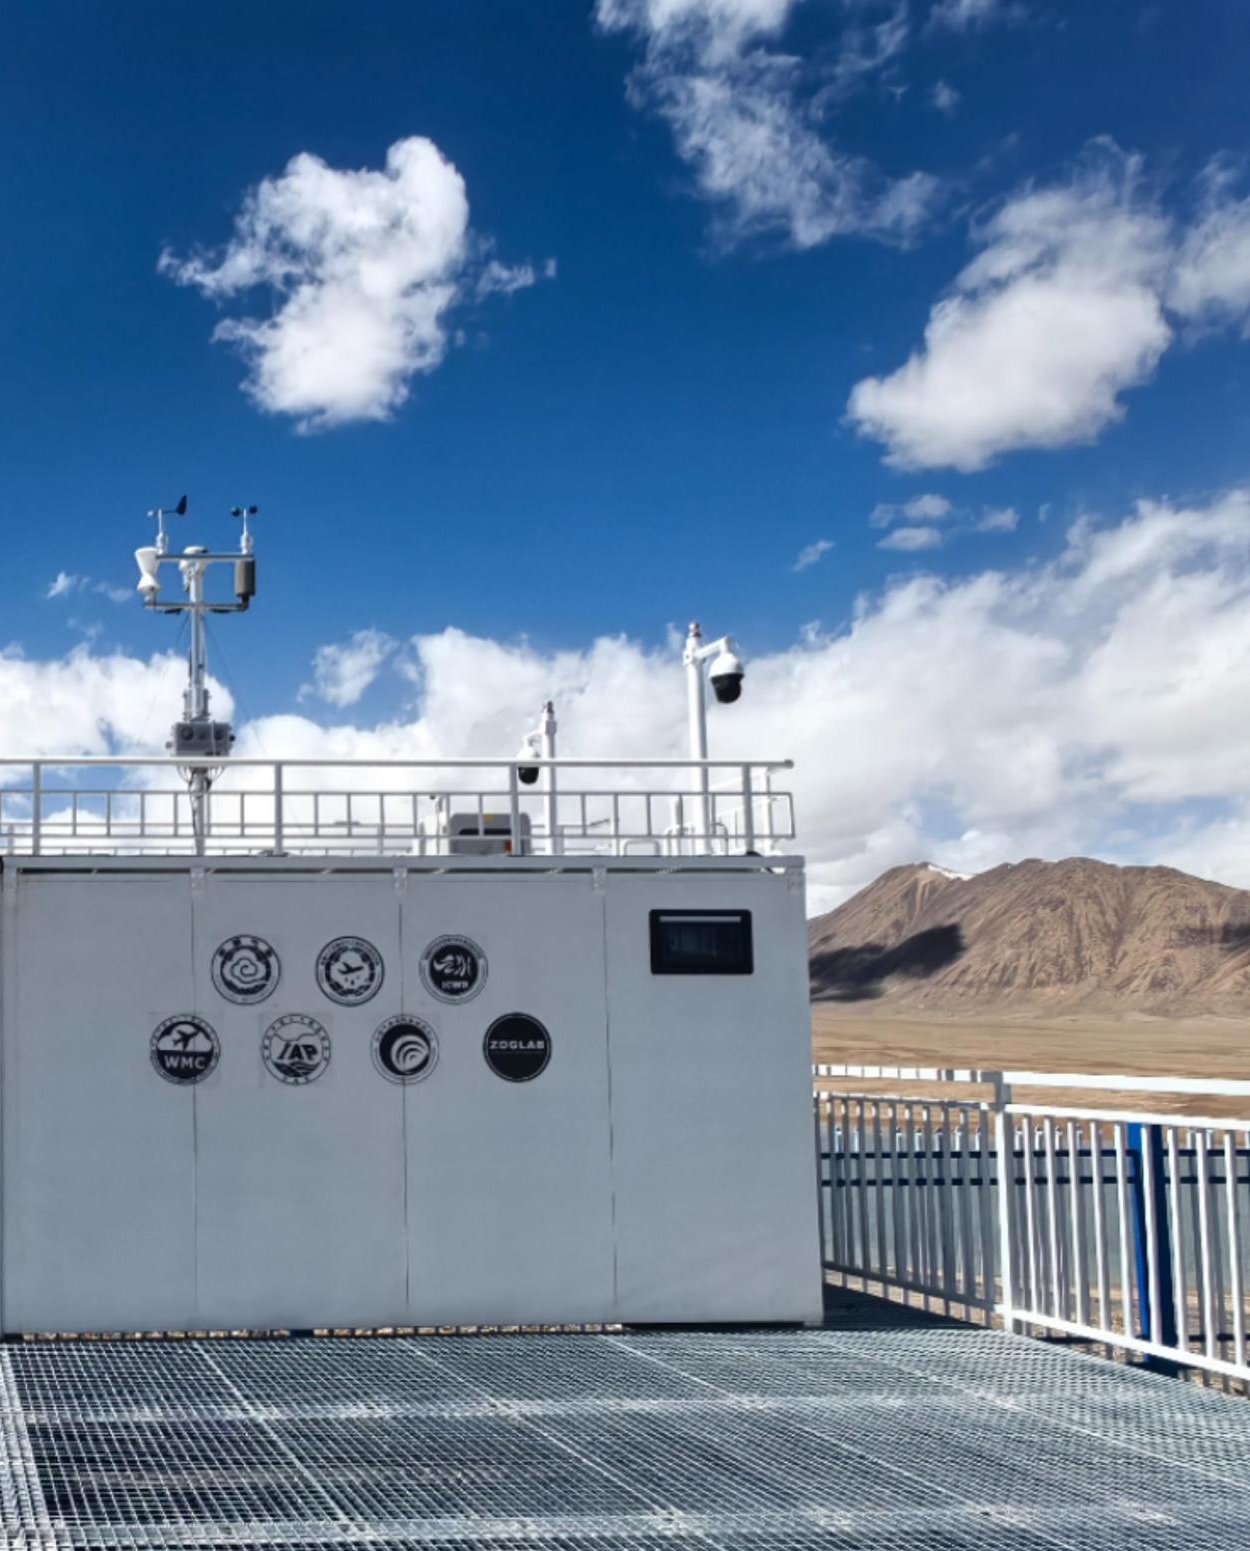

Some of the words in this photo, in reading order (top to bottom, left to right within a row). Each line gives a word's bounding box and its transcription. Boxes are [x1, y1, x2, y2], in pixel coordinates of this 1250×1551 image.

[277, 1041, 318, 1061] IAP
[489, 1040, 545, 1049] ZOGLAB
[164, 1055, 206, 1070] WMC
